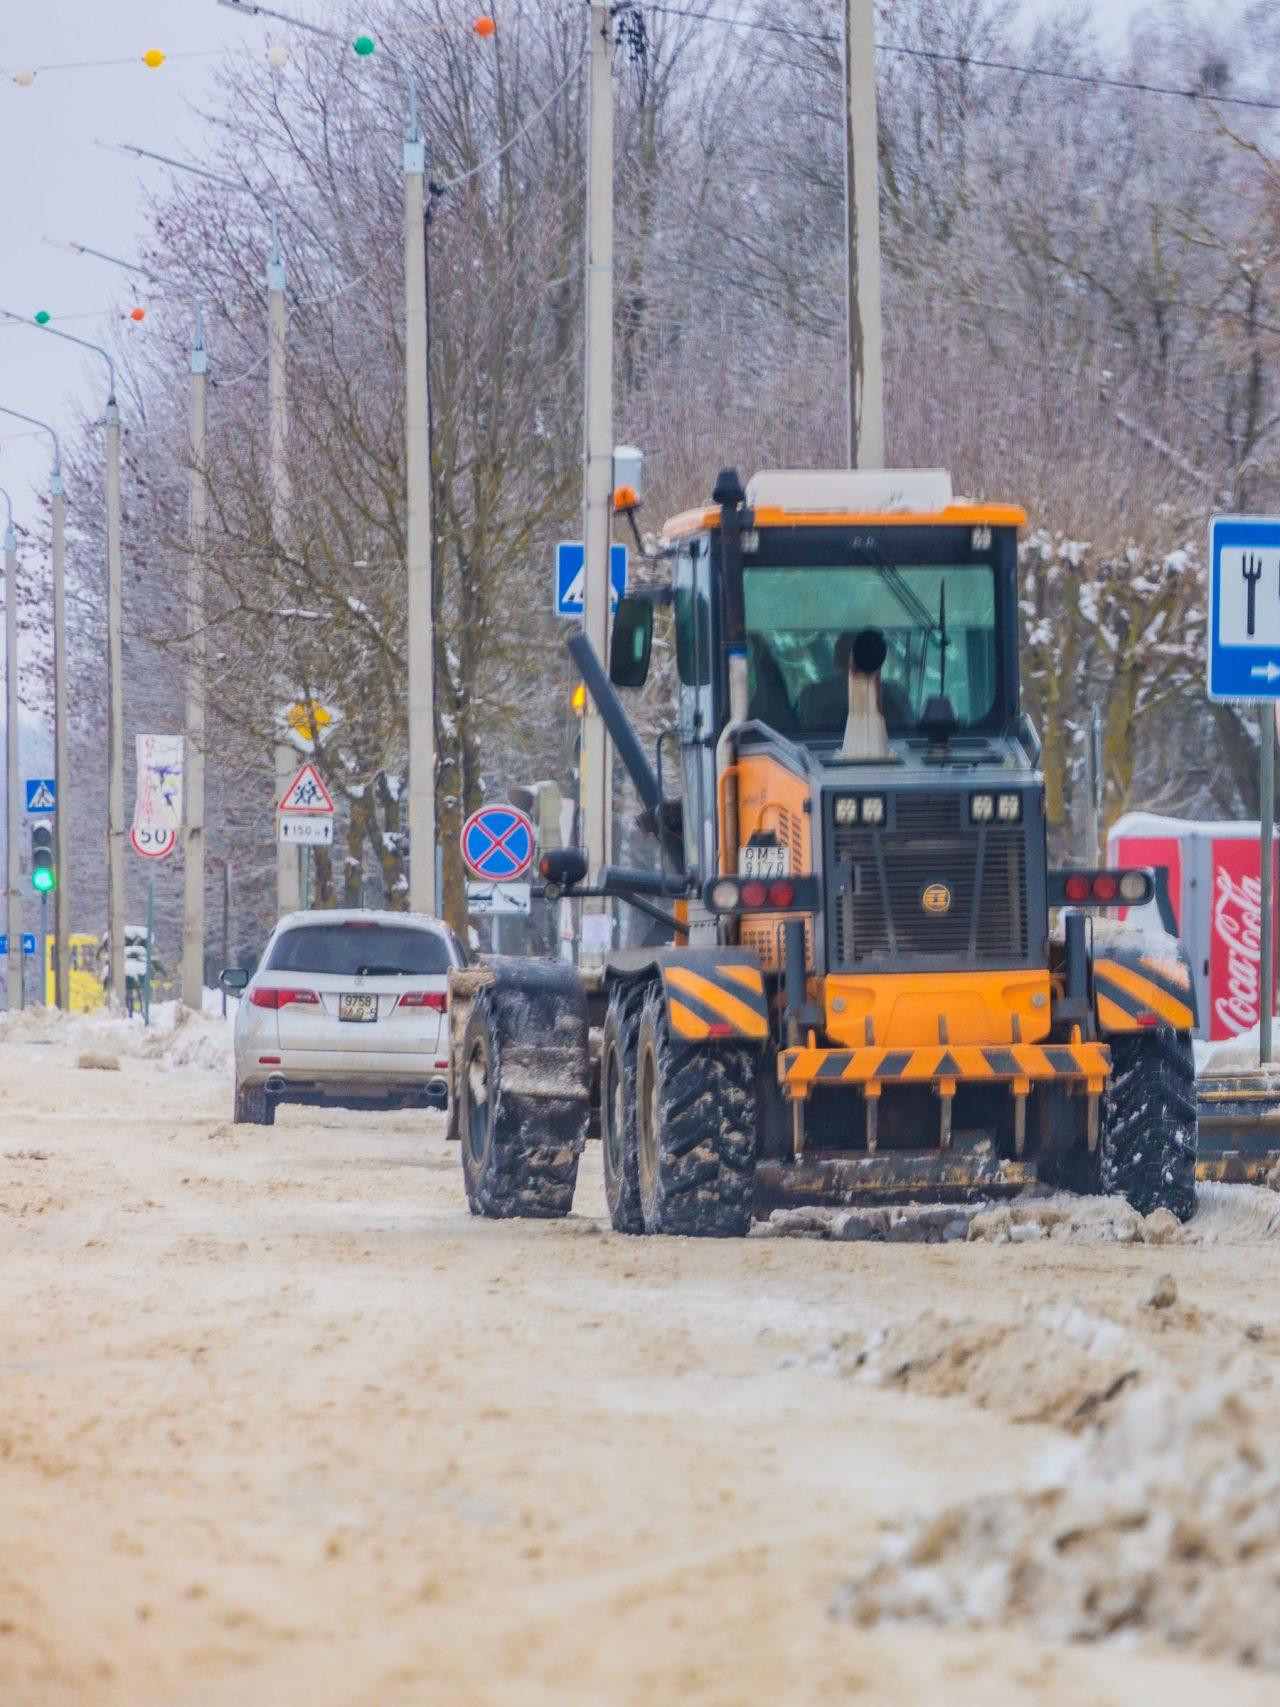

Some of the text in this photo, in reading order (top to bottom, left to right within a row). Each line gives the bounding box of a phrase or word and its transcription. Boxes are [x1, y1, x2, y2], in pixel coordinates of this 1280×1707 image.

[140, 829, 168, 843] 50
[293, 825, 312, 836] 150
[345, 994, 372, 1007] 9758
